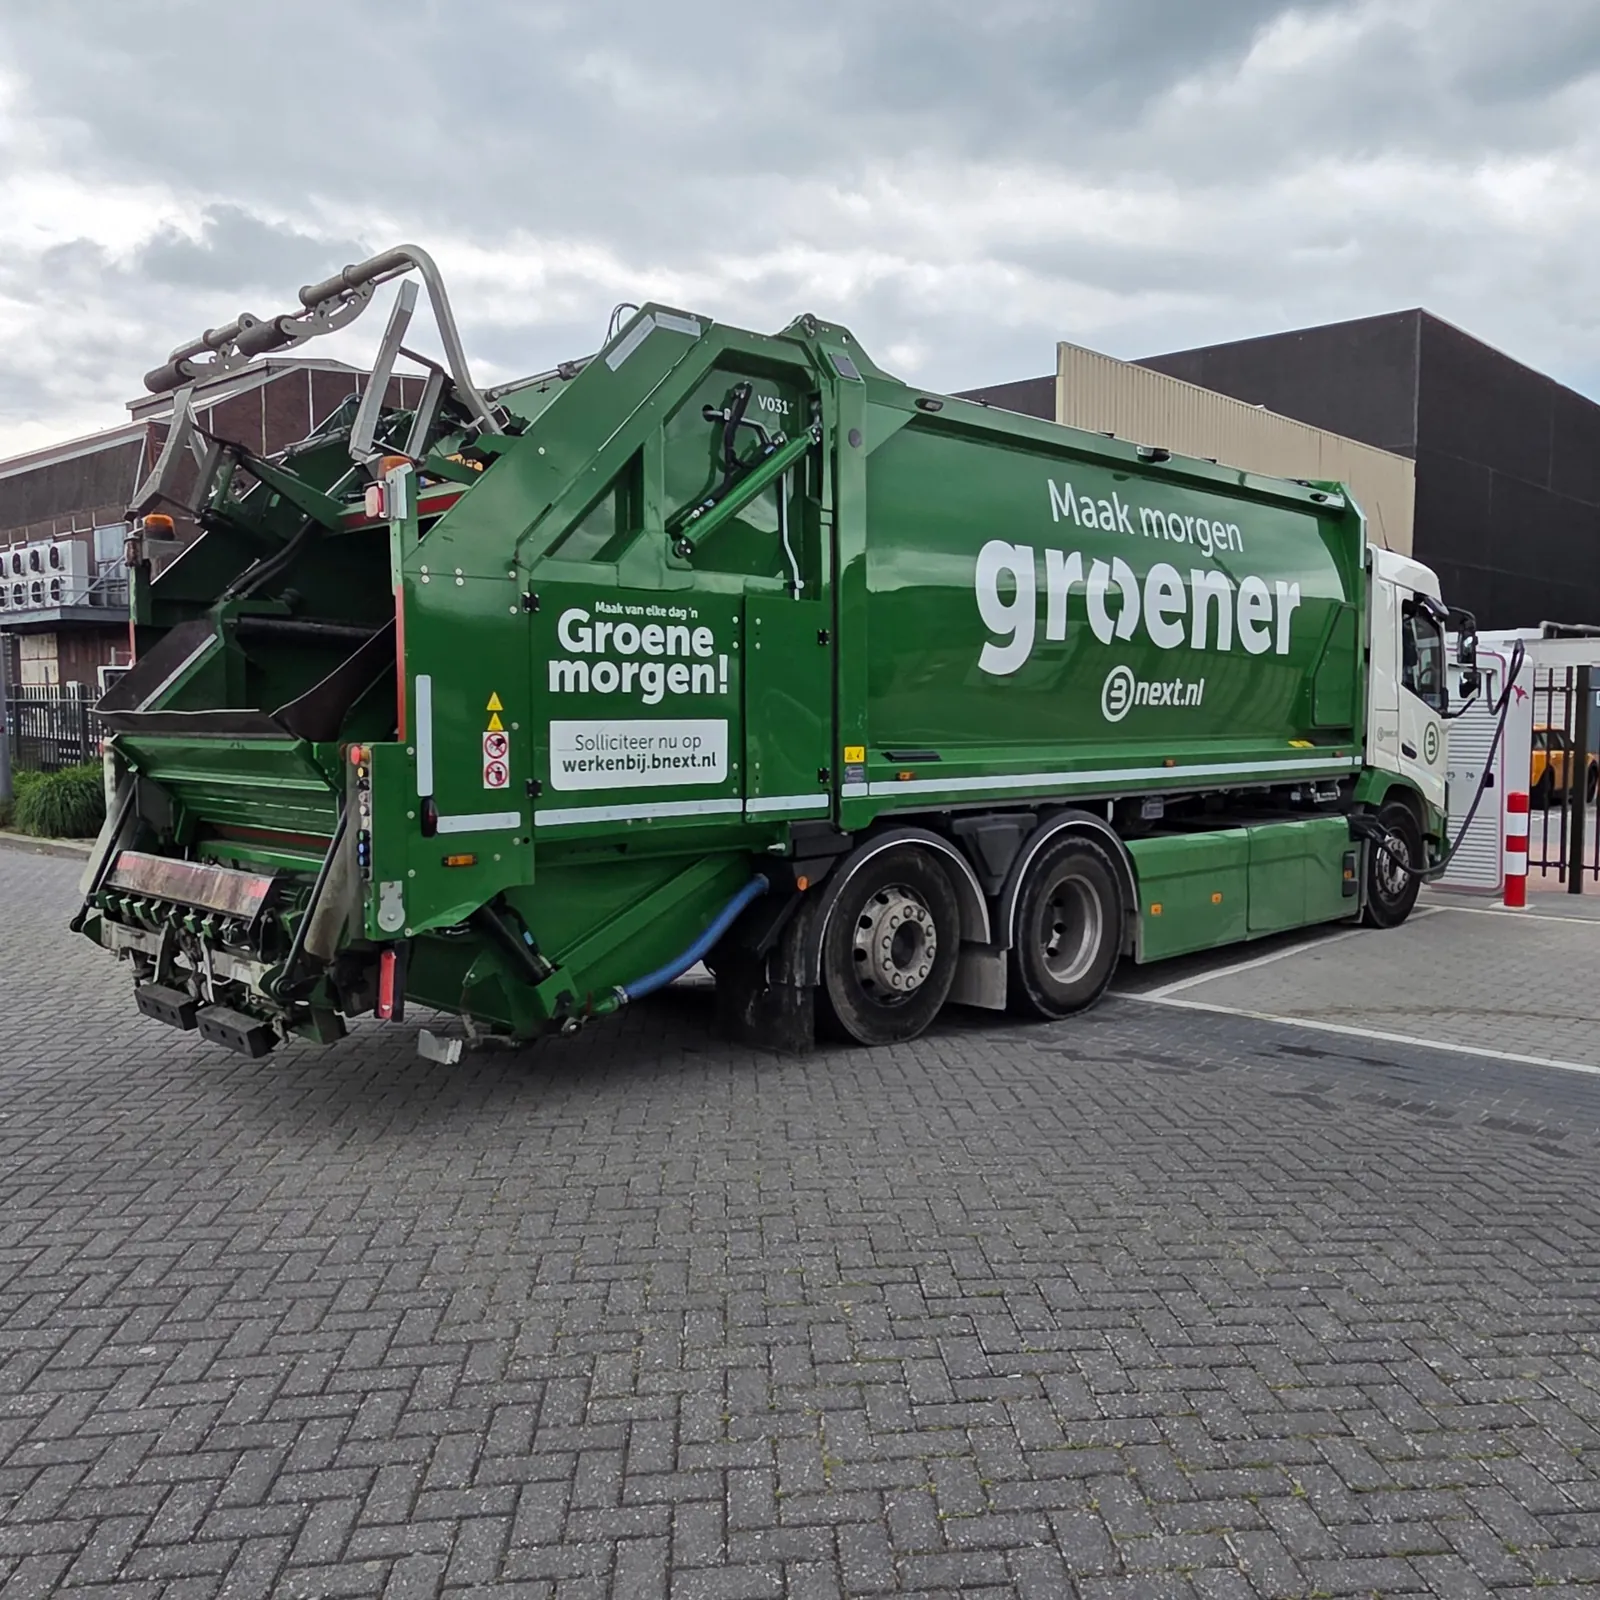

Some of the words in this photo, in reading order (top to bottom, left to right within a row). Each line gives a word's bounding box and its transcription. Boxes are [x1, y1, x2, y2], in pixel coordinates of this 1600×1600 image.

[758, 394, 789, 415] V031
[1047, 478, 1134, 535] Maak
[1139, 506, 1244, 557] morgen
[595, 601, 624, 614] Maak
[625, 605, 644, 615] van
[645, 604, 667, 617] elke
[668, 606, 687, 621] dag
[975, 539, 1301, 675] groener
[557, 608, 714, 657] Groene
[549, 654, 729, 705] morgen!
[575, 734, 654, 751] Solliciteer
[658, 736, 678, 749] nu
[682, 736, 702, 752] op
[562, 751, 717, 774] werkenbij.bnext.nl
